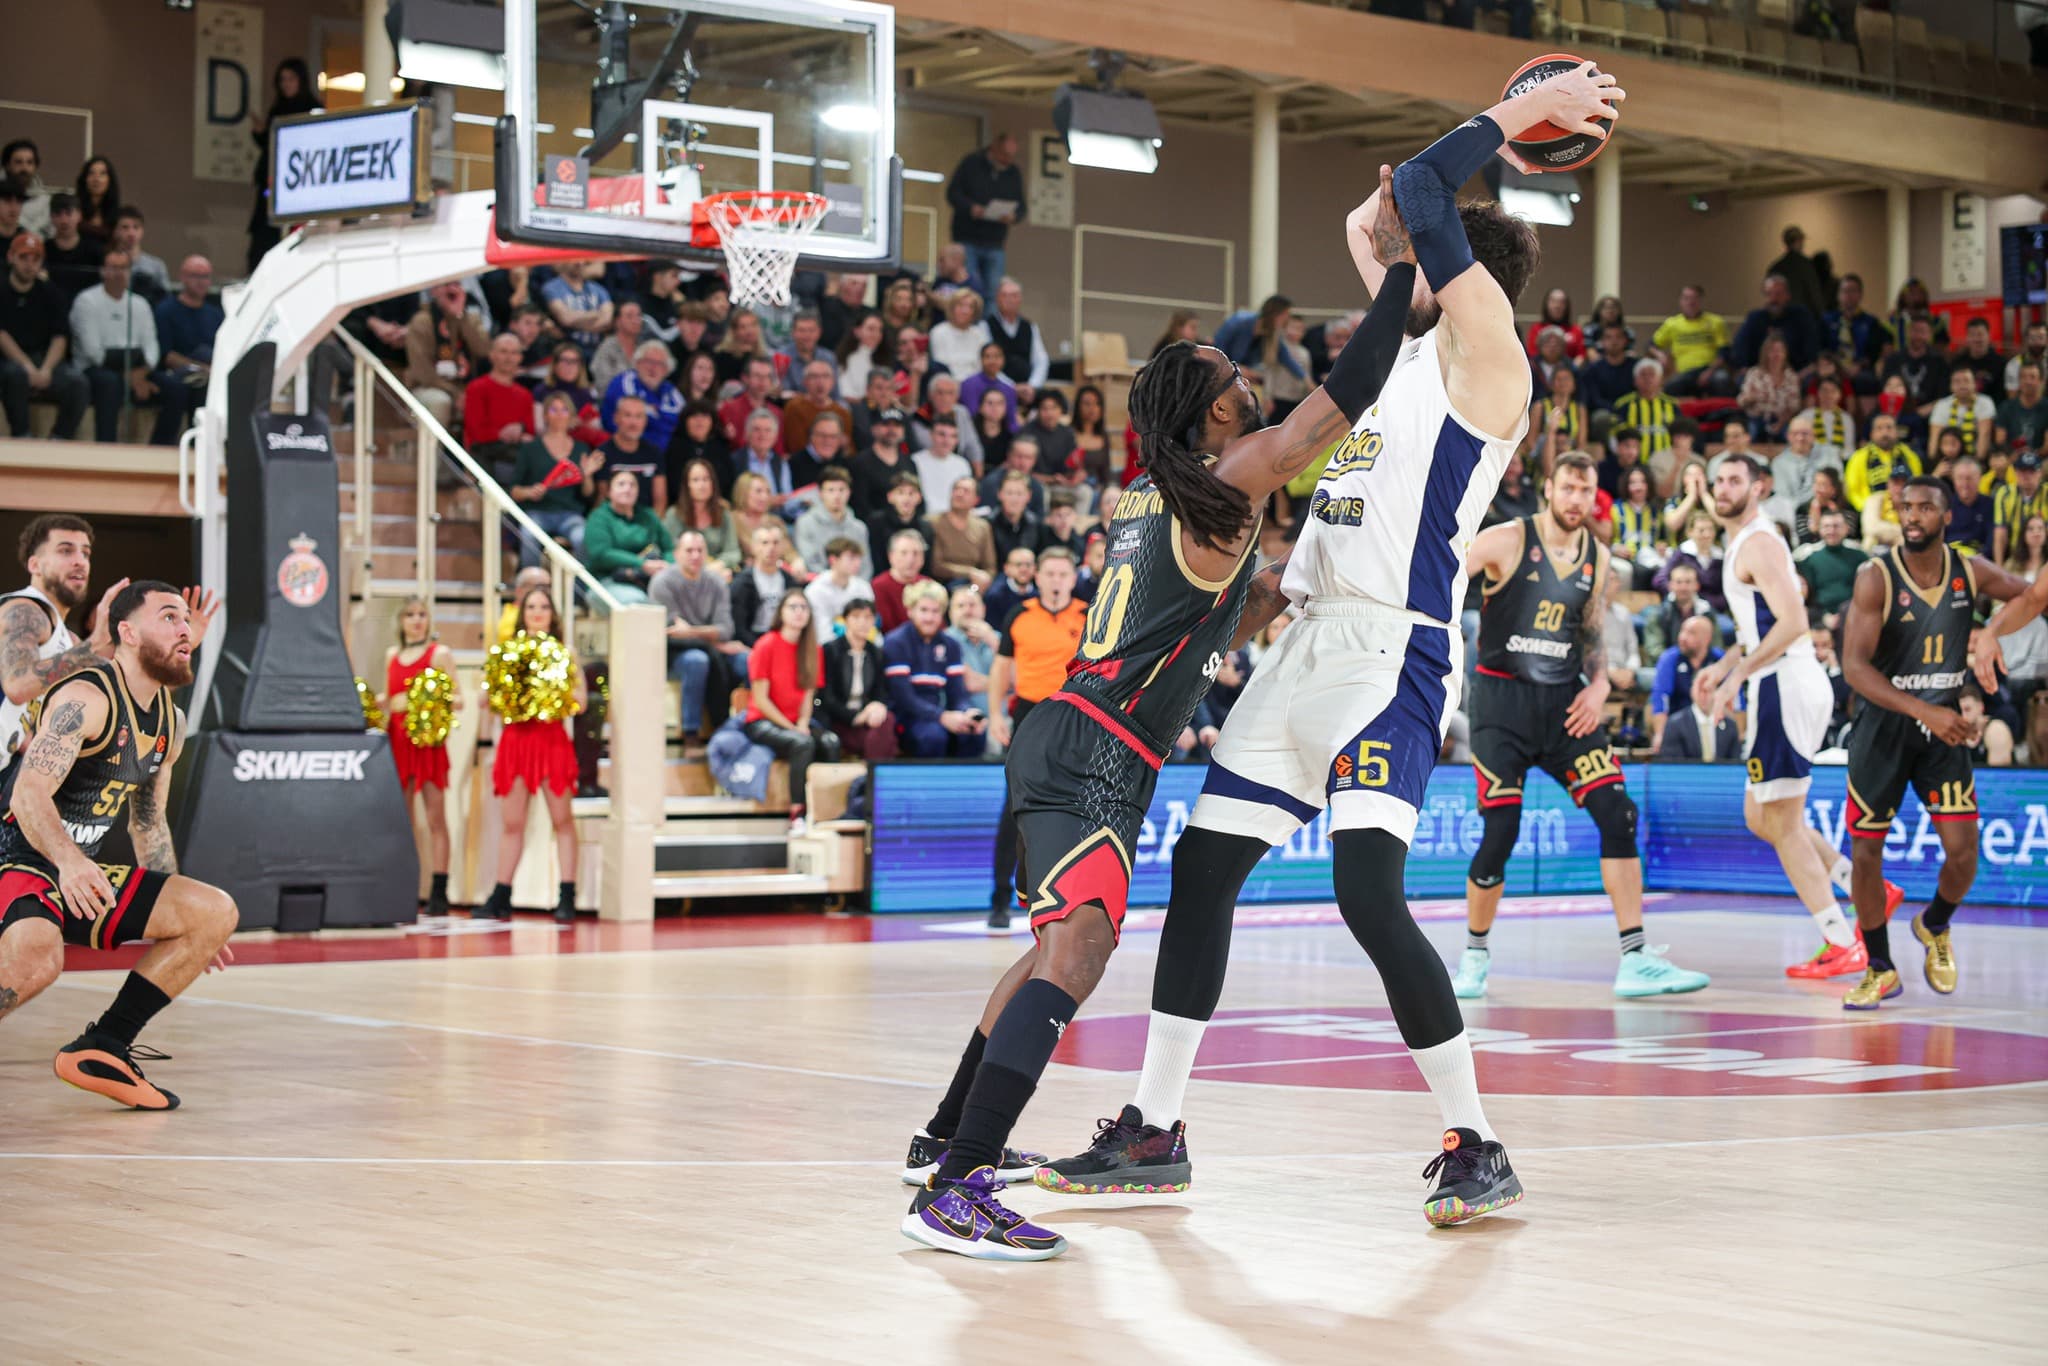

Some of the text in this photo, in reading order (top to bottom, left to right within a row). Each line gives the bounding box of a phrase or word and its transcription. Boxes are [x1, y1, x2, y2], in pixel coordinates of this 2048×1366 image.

[207, 58, 249, 124] D
[284, 138, 403, 190] SKWEEK
[1041, 135, 1065, 180] E
[1953, 190, 1975, 230] E
[1534, 599, 1566, 633] 20
[1505, 634, 1573, 660] SKWEEK
[1922, 633, 1944, 664] 11
[1891, 669, 1967, 690] SKWEEK
[233, 749, 371, 782] SKWEEK
[1358, 740, 1391, 786] 5
[1747, 757, 1764, 783] 9
